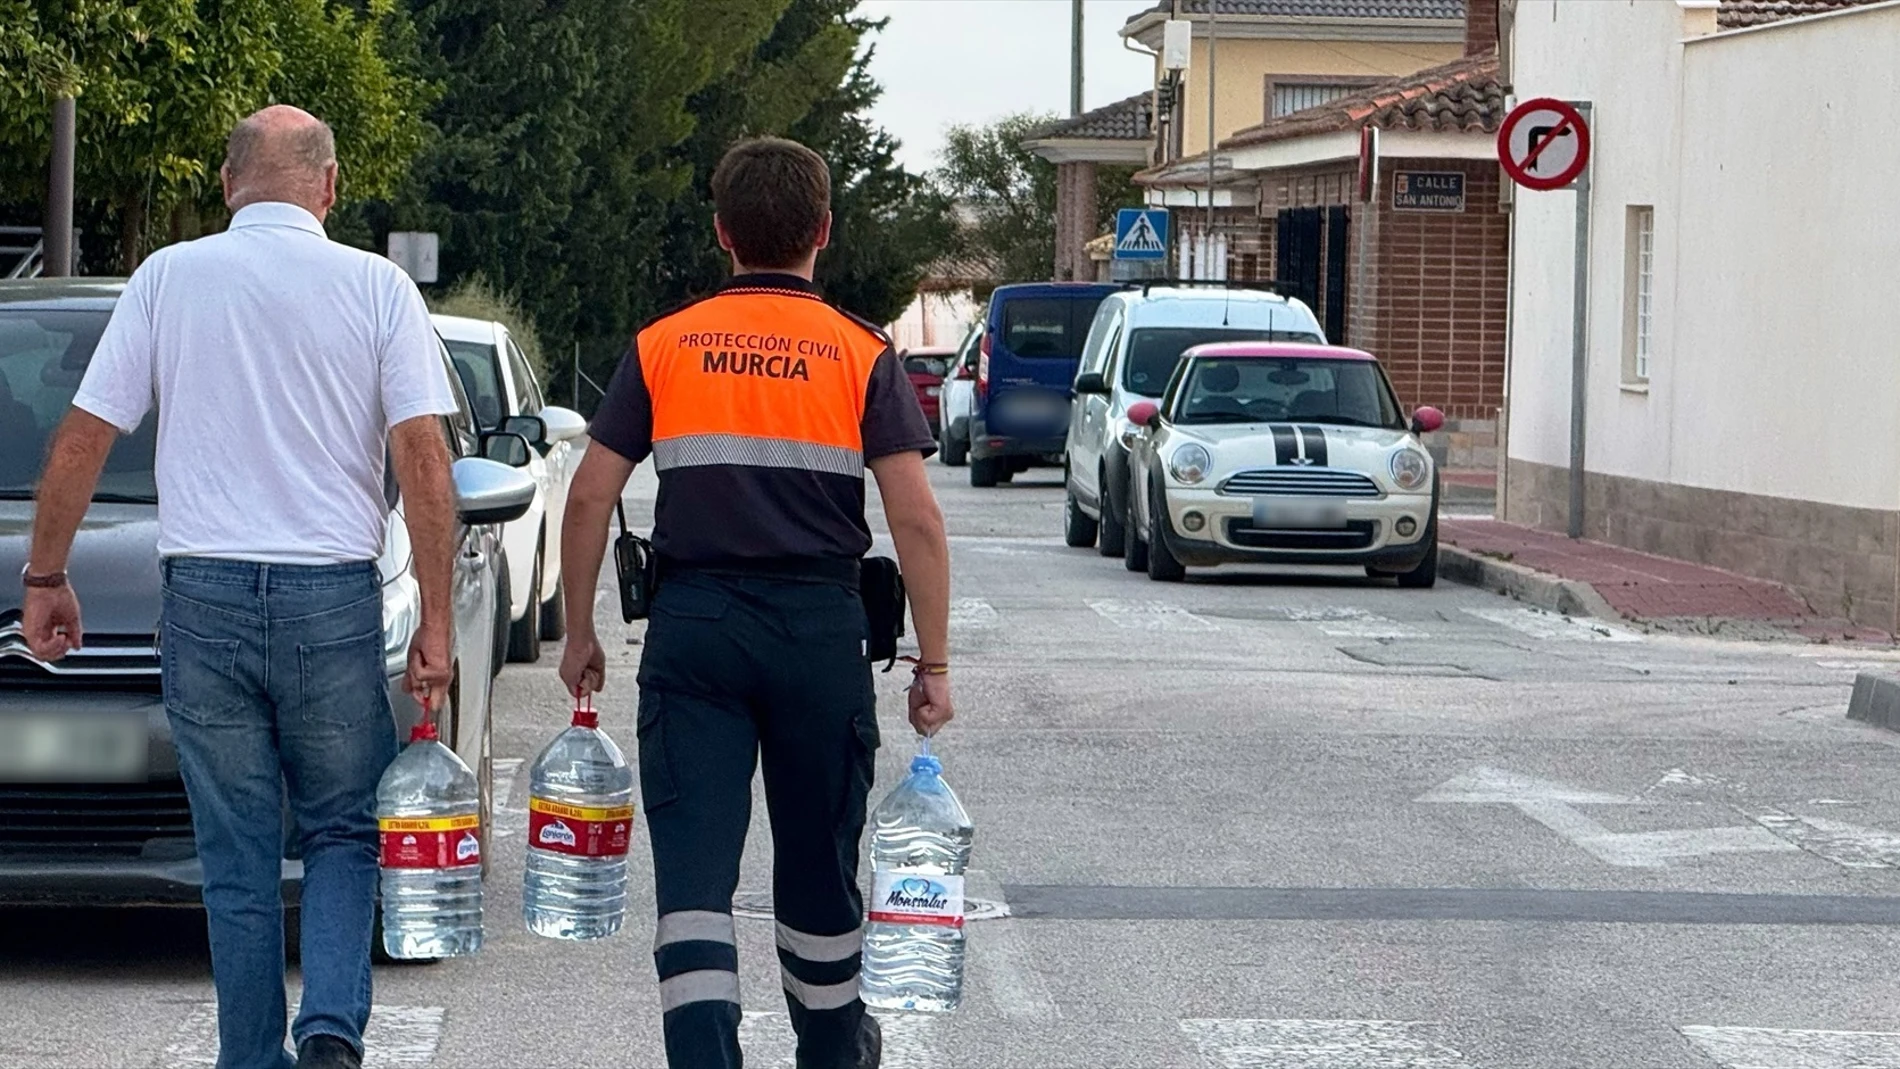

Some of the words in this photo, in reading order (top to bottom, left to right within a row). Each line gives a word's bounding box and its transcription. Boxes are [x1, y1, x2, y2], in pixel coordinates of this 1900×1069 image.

[1416, 176, 1457, 189] CALLE
[1395, 194, 1417, 206] SAN
[1419, 195, 1462, 207] ANTONIO
[678, 332, 791, 352] PROTECCIÓN
[797, 339, 842, 362] CIVIL
[702, 350, 810, 382] MURCIA
[885, 890, 948, 910] Monssalus
